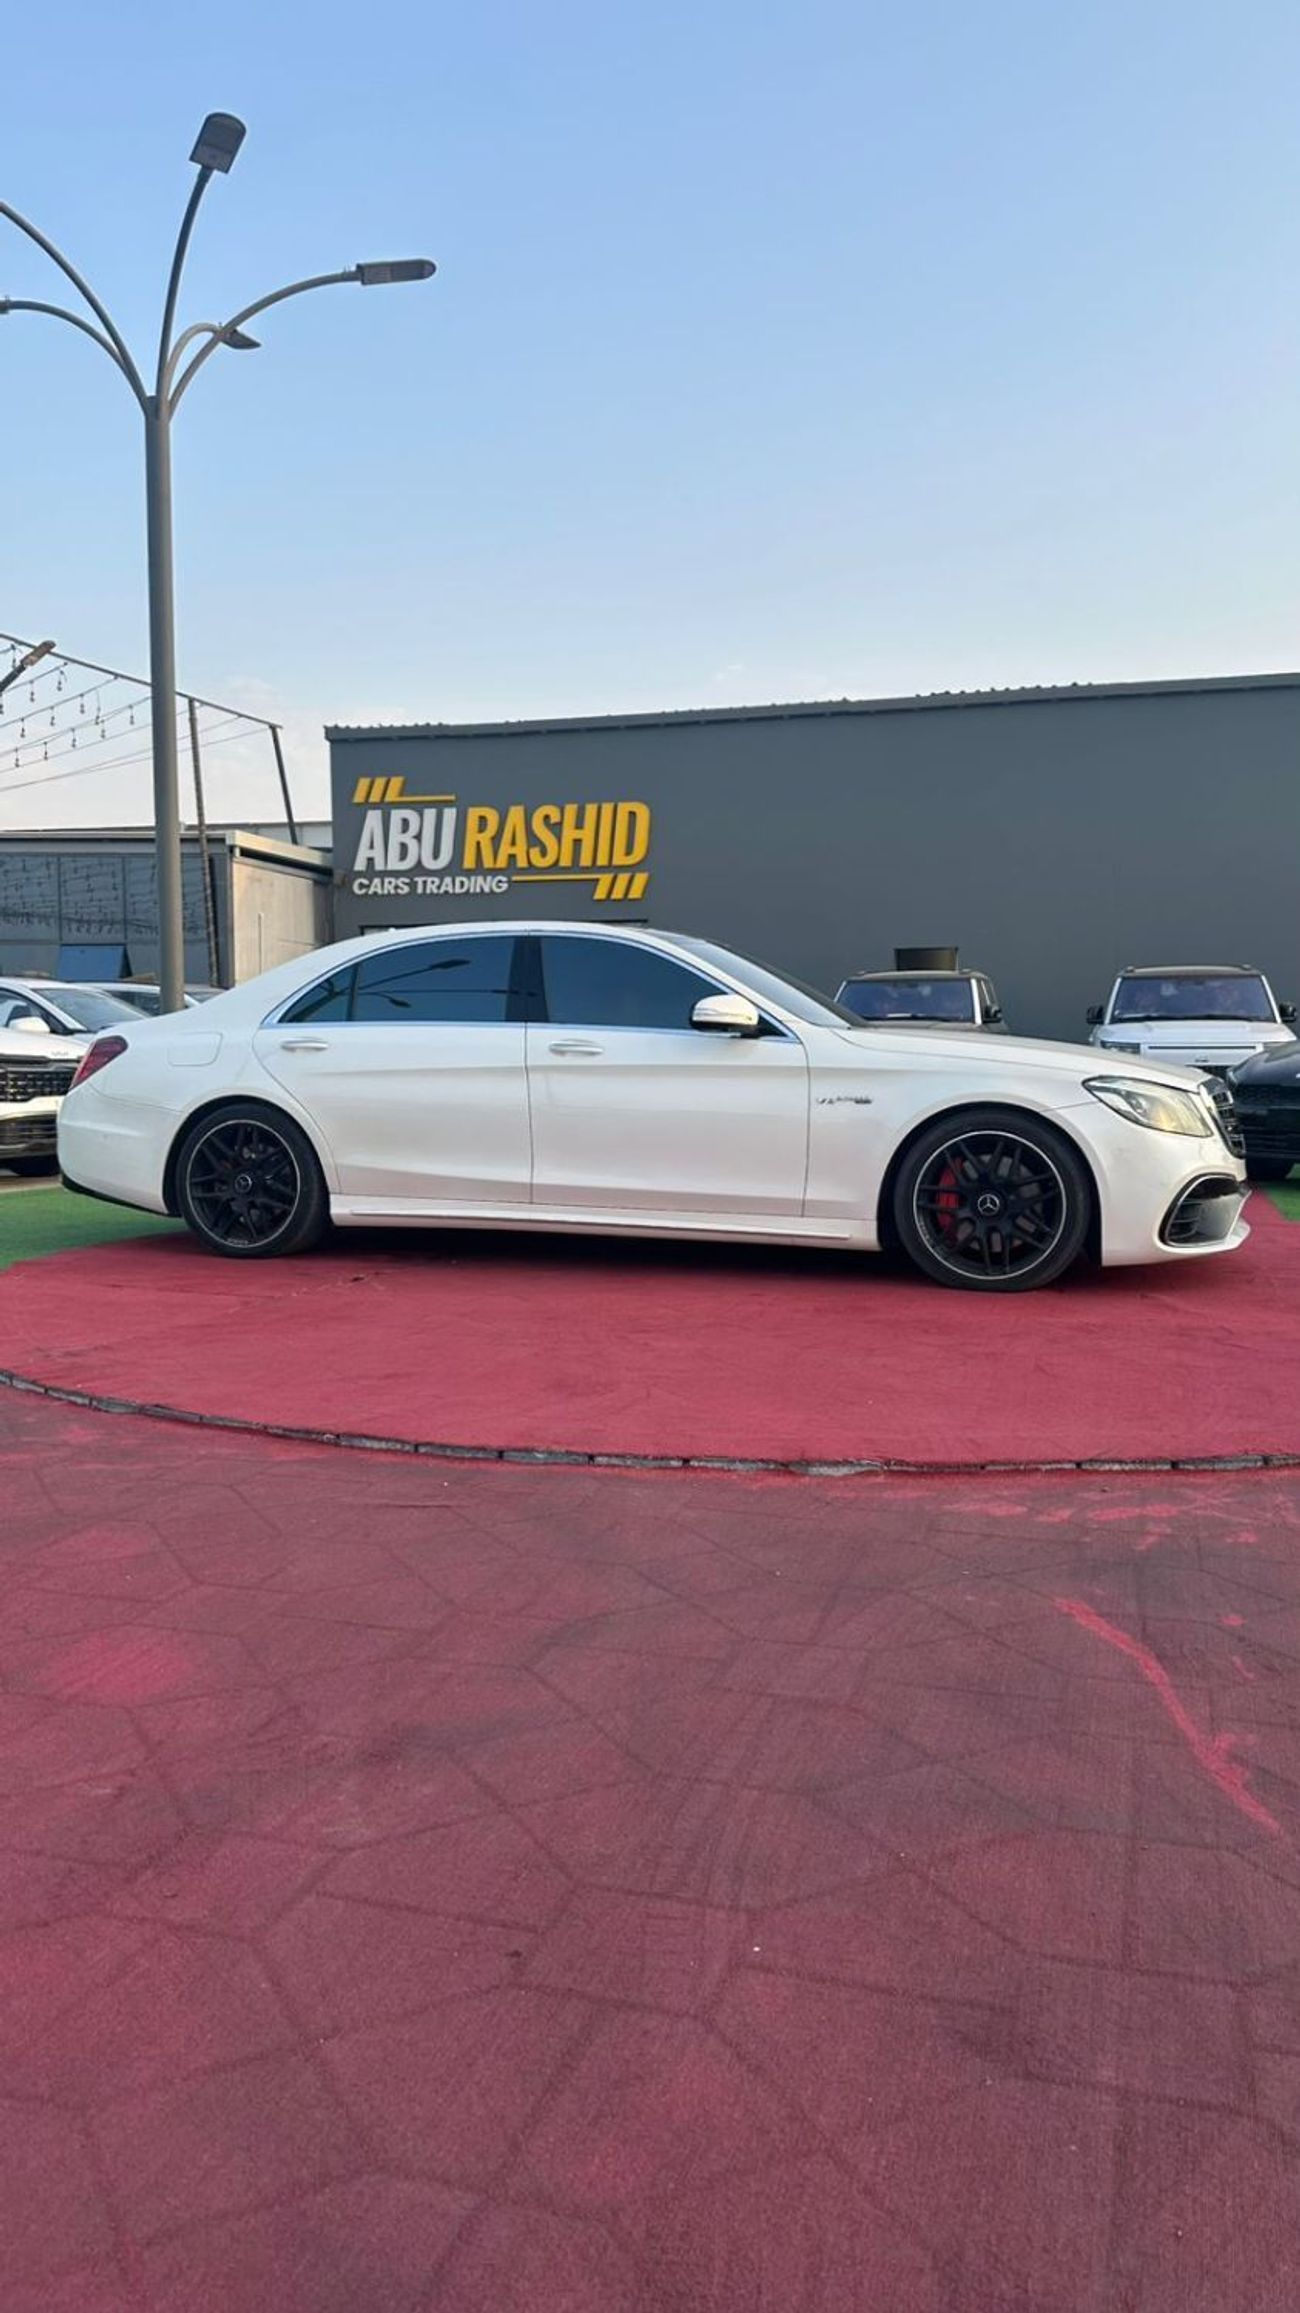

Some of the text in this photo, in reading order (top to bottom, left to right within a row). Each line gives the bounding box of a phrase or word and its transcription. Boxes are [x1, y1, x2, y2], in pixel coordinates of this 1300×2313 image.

[353, 802, 650, 871] ABU RASHID
[352, 875, 508, 895] CARS TRADING
